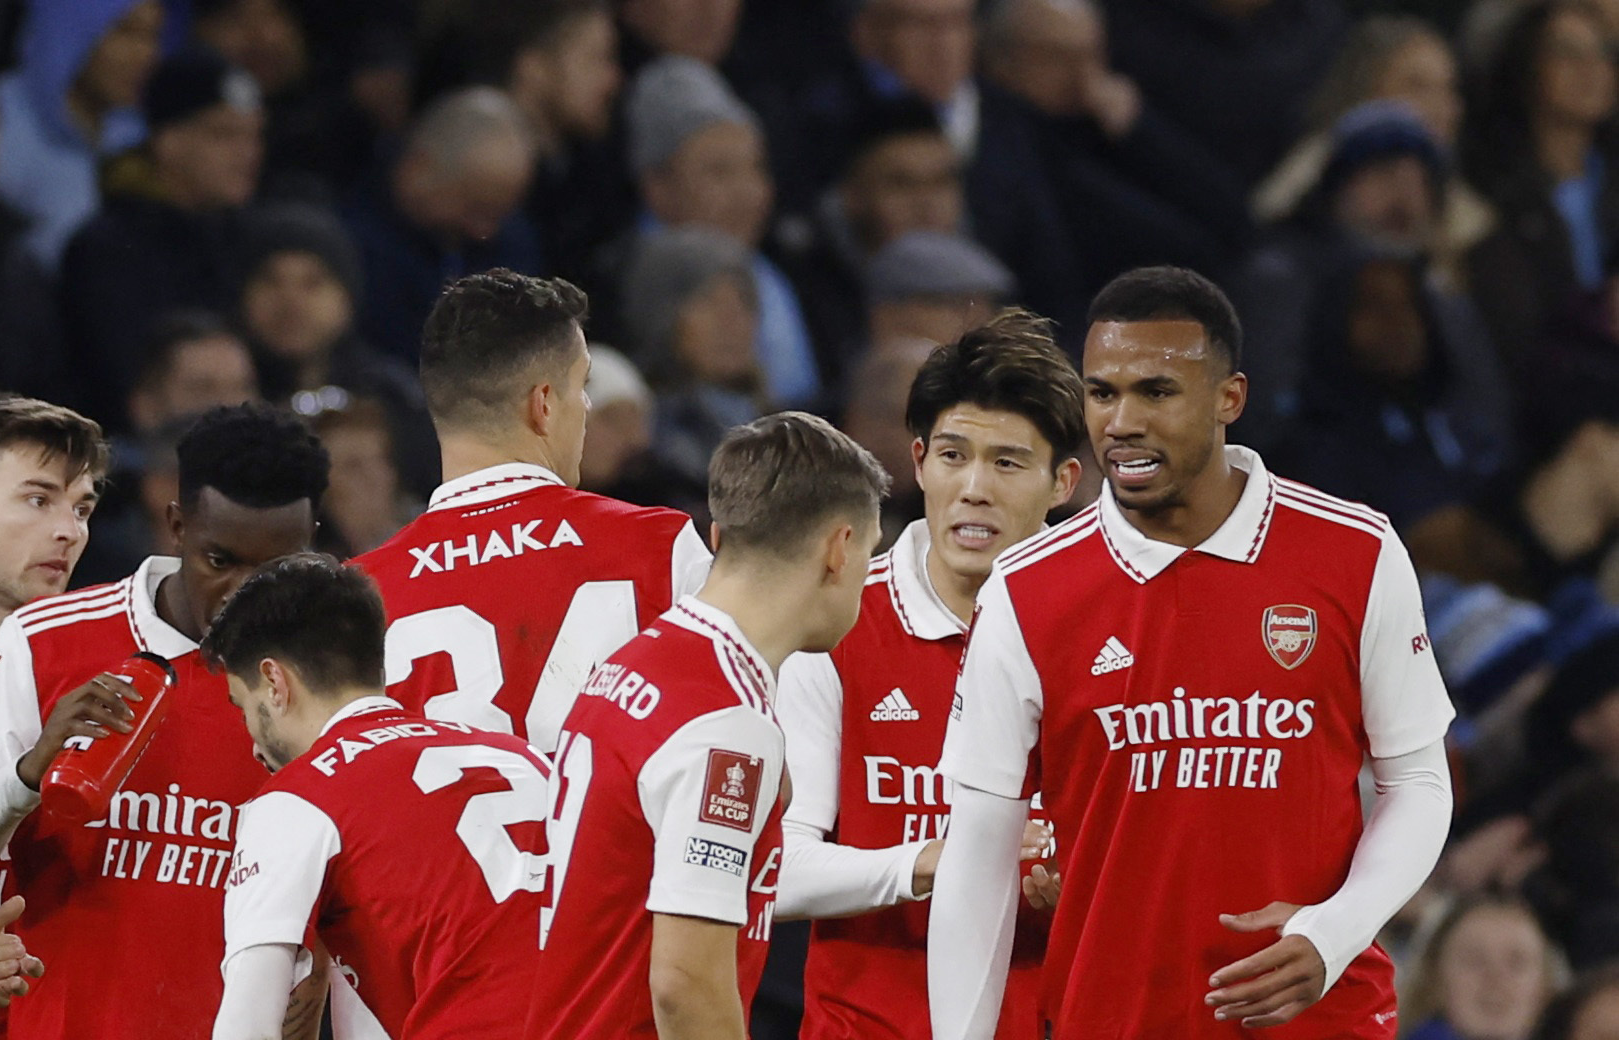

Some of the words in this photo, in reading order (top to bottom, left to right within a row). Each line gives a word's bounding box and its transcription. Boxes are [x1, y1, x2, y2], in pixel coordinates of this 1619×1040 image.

[408, 518, 584, 579] XHAKA
[1270, 614, 1310, 627] Arsenal
[1090, 653, 1134, 676] adidas
[869, 708, 920, 722] adidas
[1093, 686, 1315, 751] Emirates
[310, 722, 438, 777] FÁBIO
[1176, 746, 1282, 789] BETTER
[708, 803, 724, 817] FA
[725, 806, 749, 822] CUP
[710, 793, 750, 812] Emirates
[684, 850, 707, 866] for
[687, 837, 708, 854] No
[709, 843, 743, 864] room
[101, 837, 152, 880] FLY
[156, 843, 232, 890] BETT
